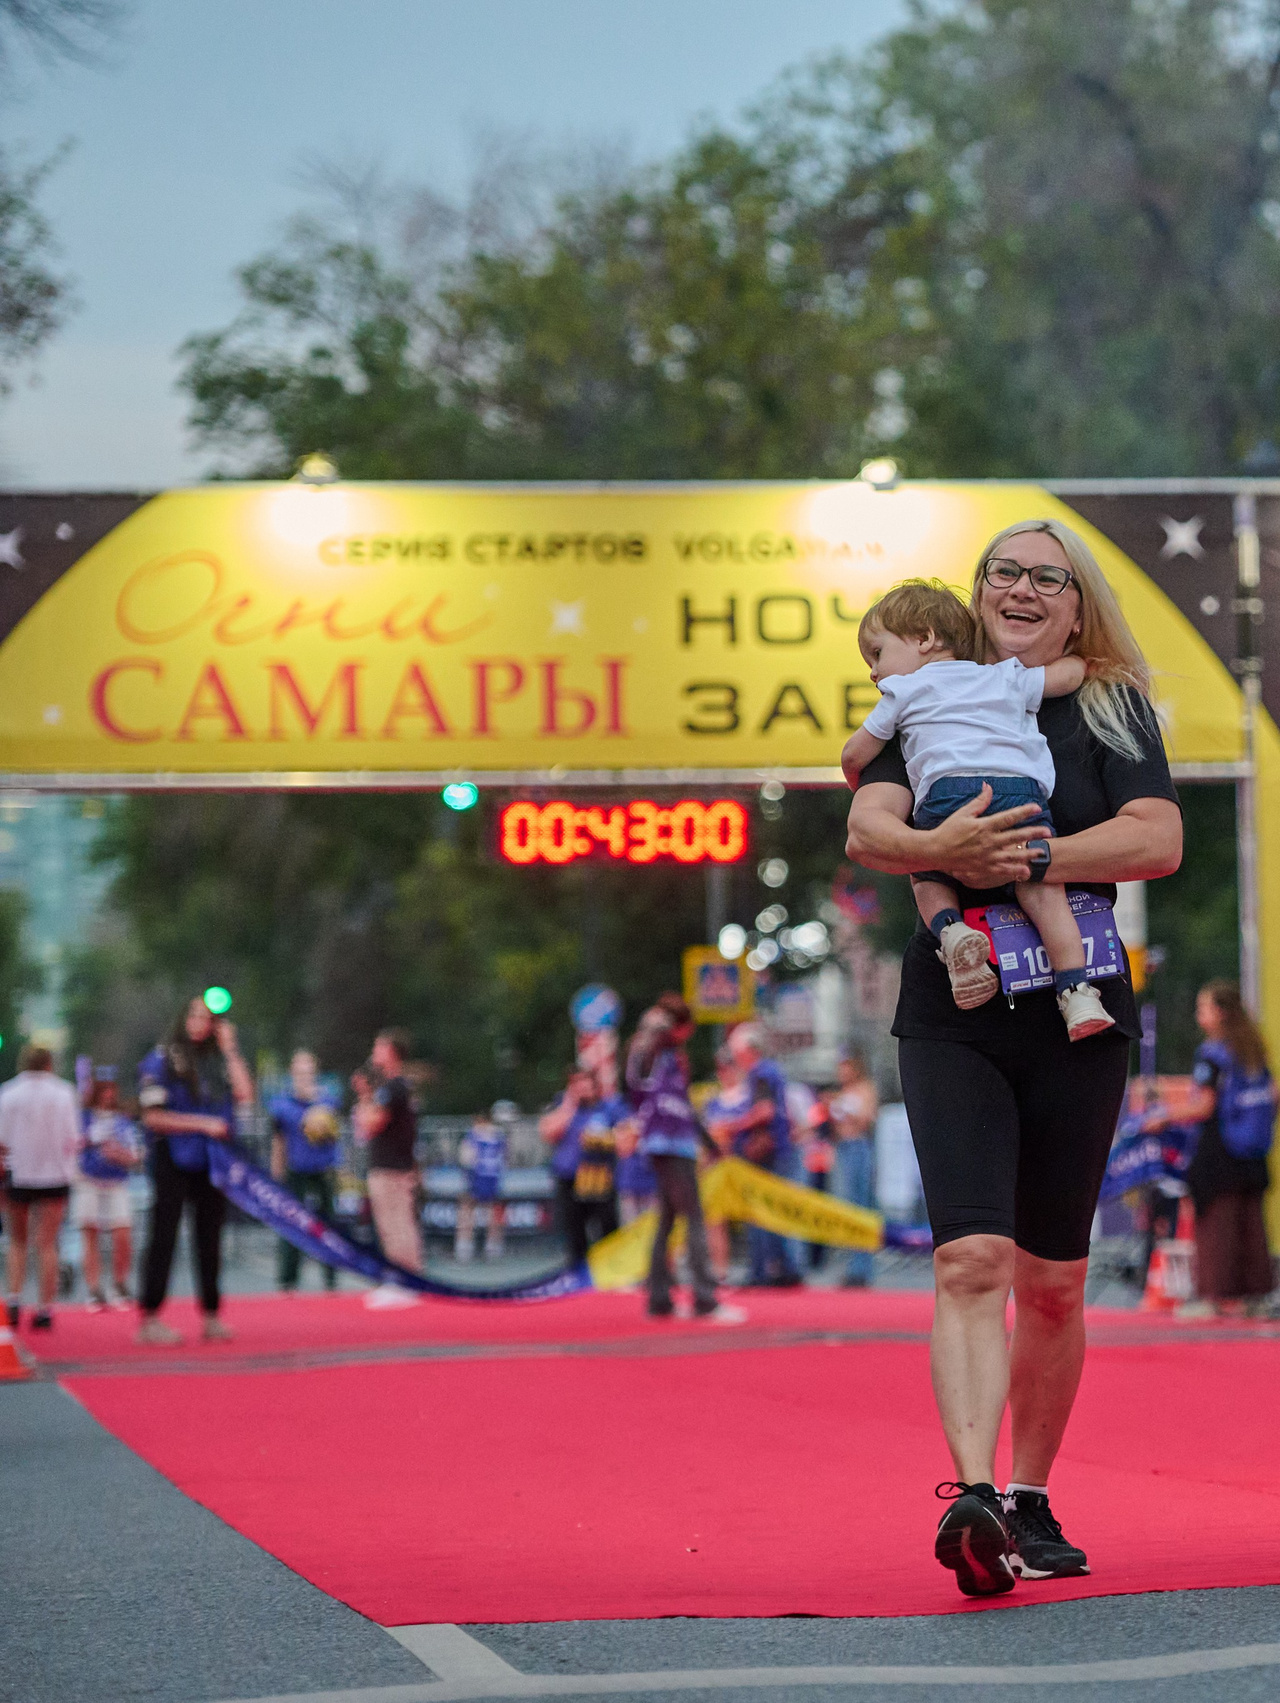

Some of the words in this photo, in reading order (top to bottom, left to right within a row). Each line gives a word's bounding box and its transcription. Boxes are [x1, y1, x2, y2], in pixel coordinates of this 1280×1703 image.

[318, 533, 452, 565] СЕРИЯ
[463, 532, 648, 566] СТАРТОВ
[115, 549, 495, 646] Огни
[681, 594, 884, 643] НОЧ
[90, 655, 632, 743] САМАРЫ
[500, 800, 748, 865] 00:43:00
[1000, 911, 1026, 923] САМ
[1022, 936, 1094, 976] 107
